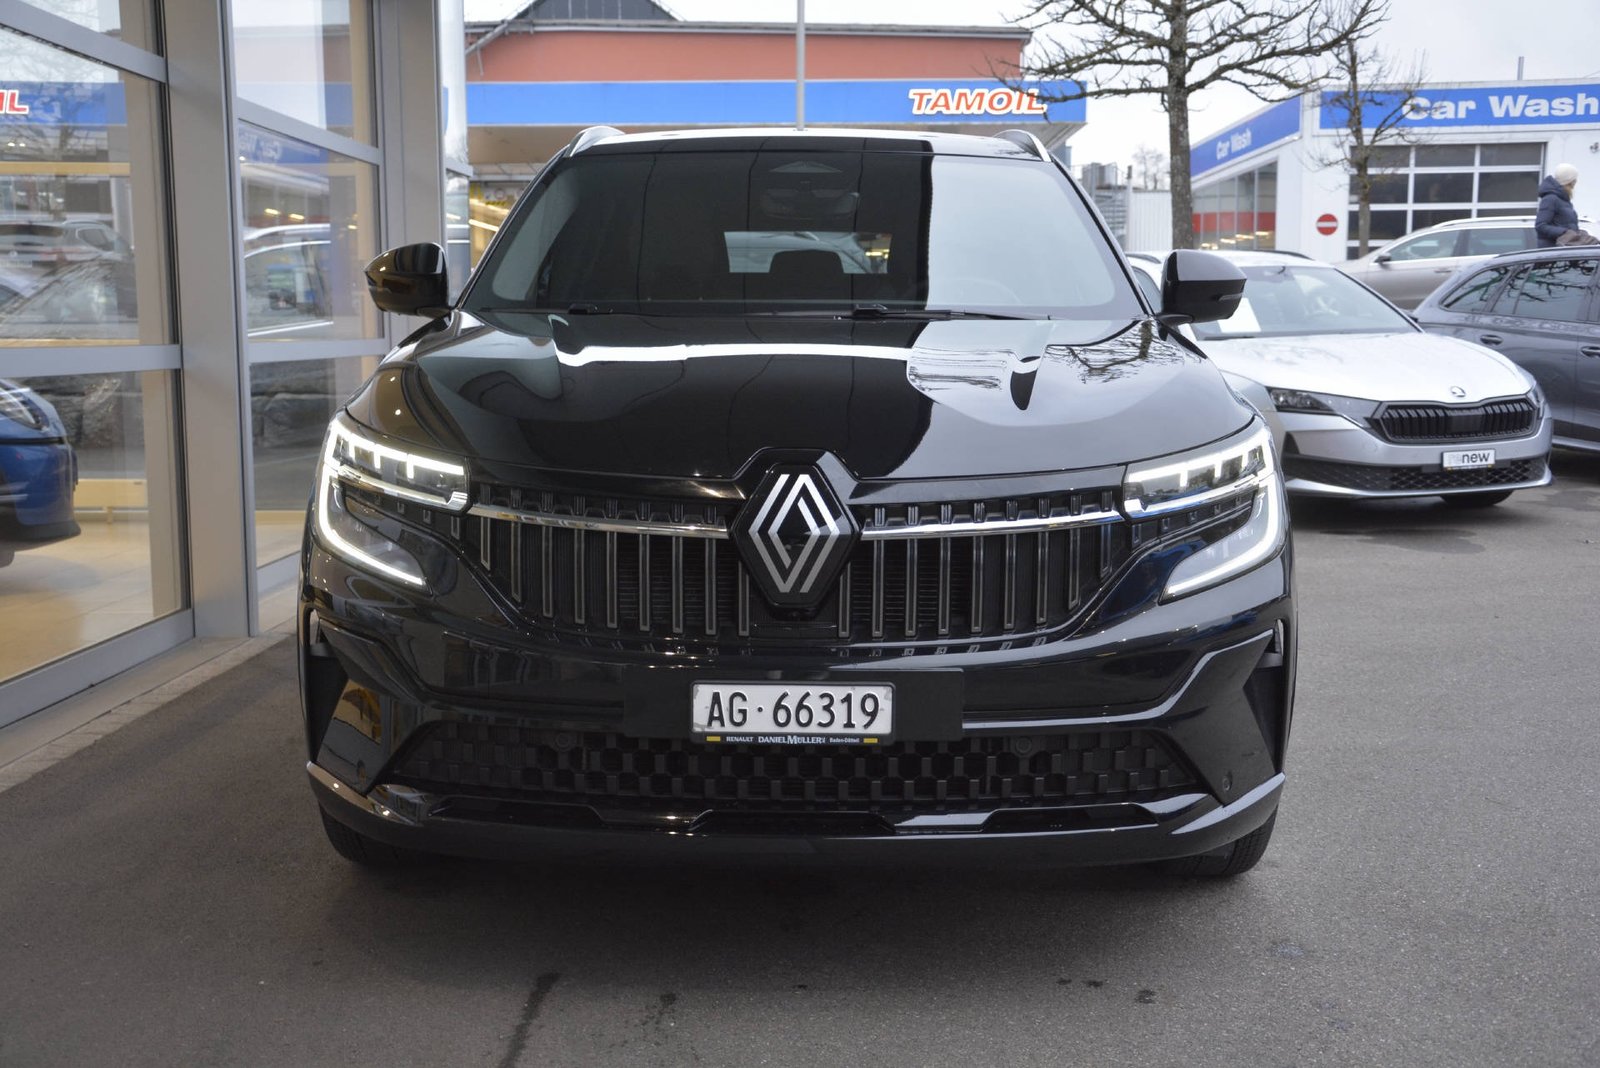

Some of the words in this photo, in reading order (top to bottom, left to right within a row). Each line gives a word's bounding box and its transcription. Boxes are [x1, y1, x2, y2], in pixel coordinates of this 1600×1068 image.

[909, 88, 1047, 115] TAMOIL
[1402, 97, 1477, 120] Car
[1488, 93, 1600, 118] Wash
[1216, 140, 1230, 160] Car
[773, 691, 880, 729] 66319
